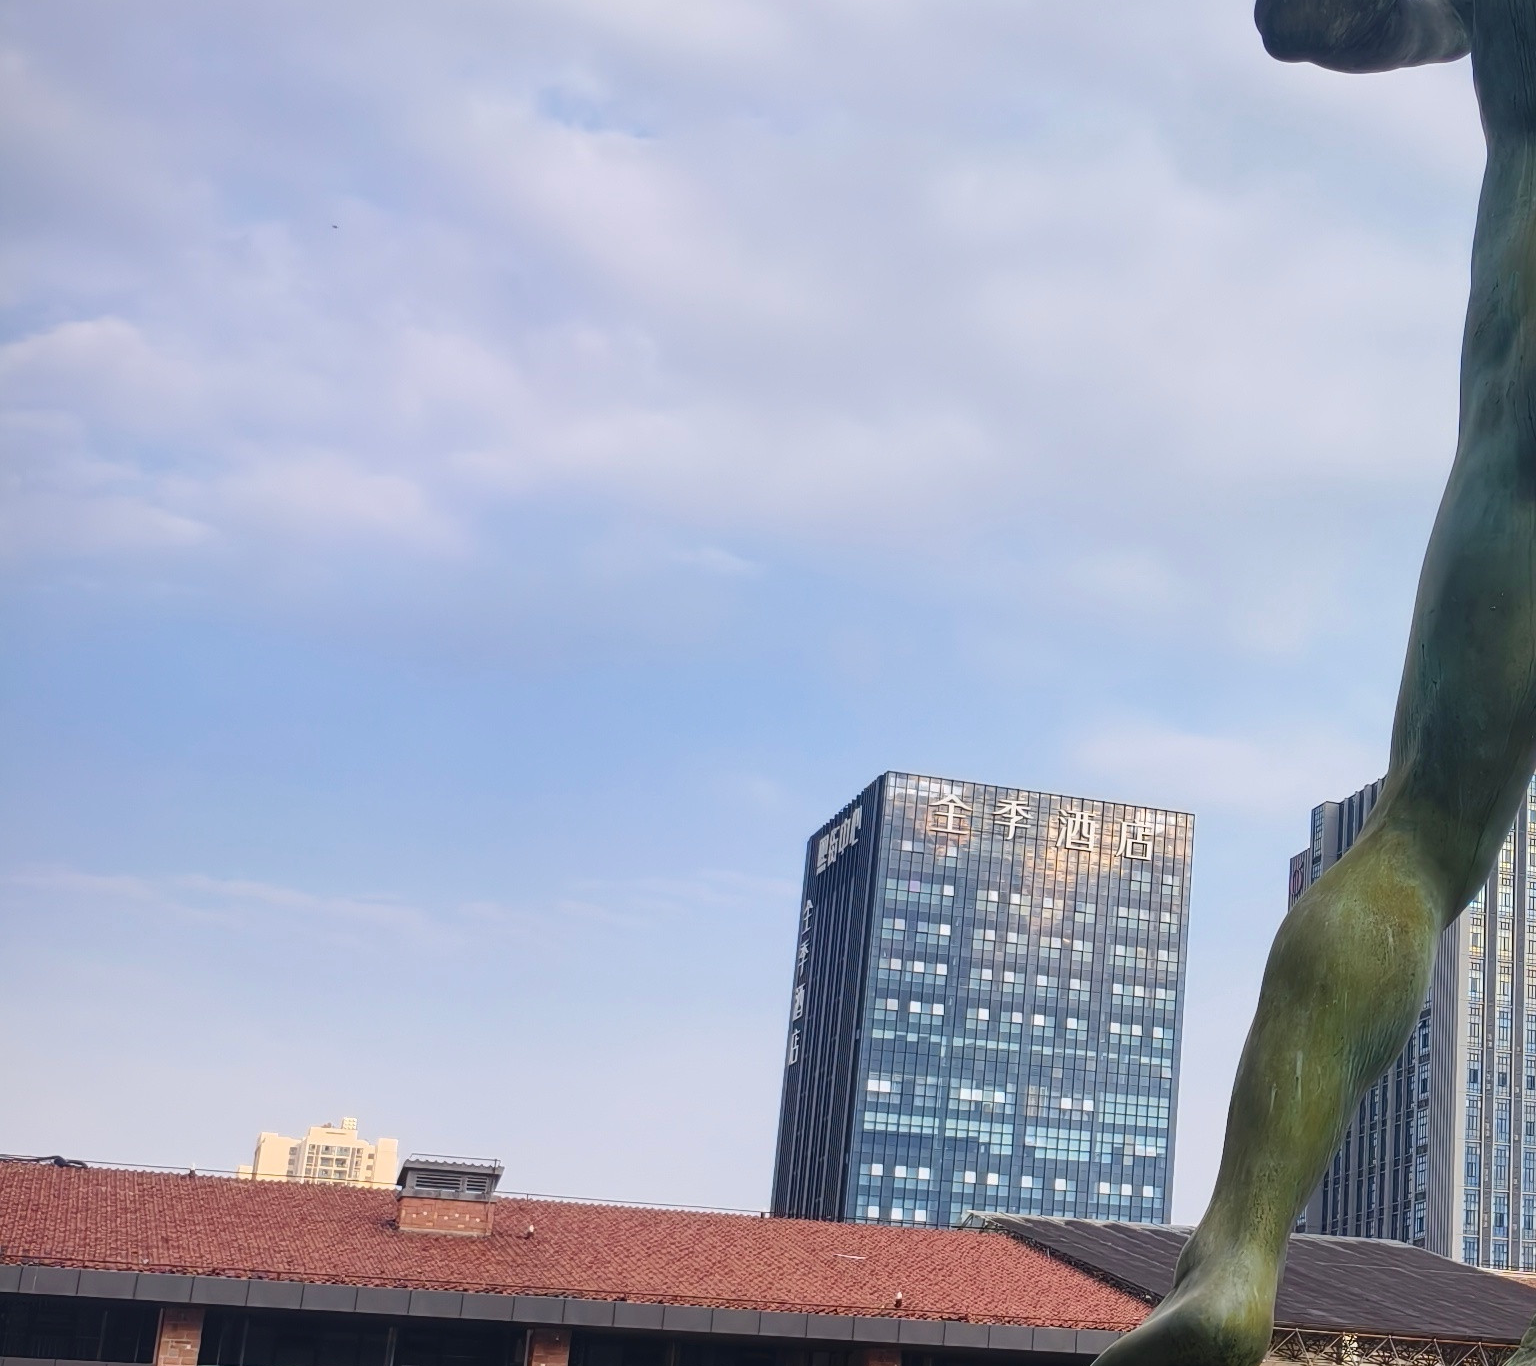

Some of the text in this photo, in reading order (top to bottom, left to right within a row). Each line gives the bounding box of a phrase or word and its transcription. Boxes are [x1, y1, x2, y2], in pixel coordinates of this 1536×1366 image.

[928, 793, 1154, 861] 全季酒店
[787, 899, 813, 1066] 全季酒店
